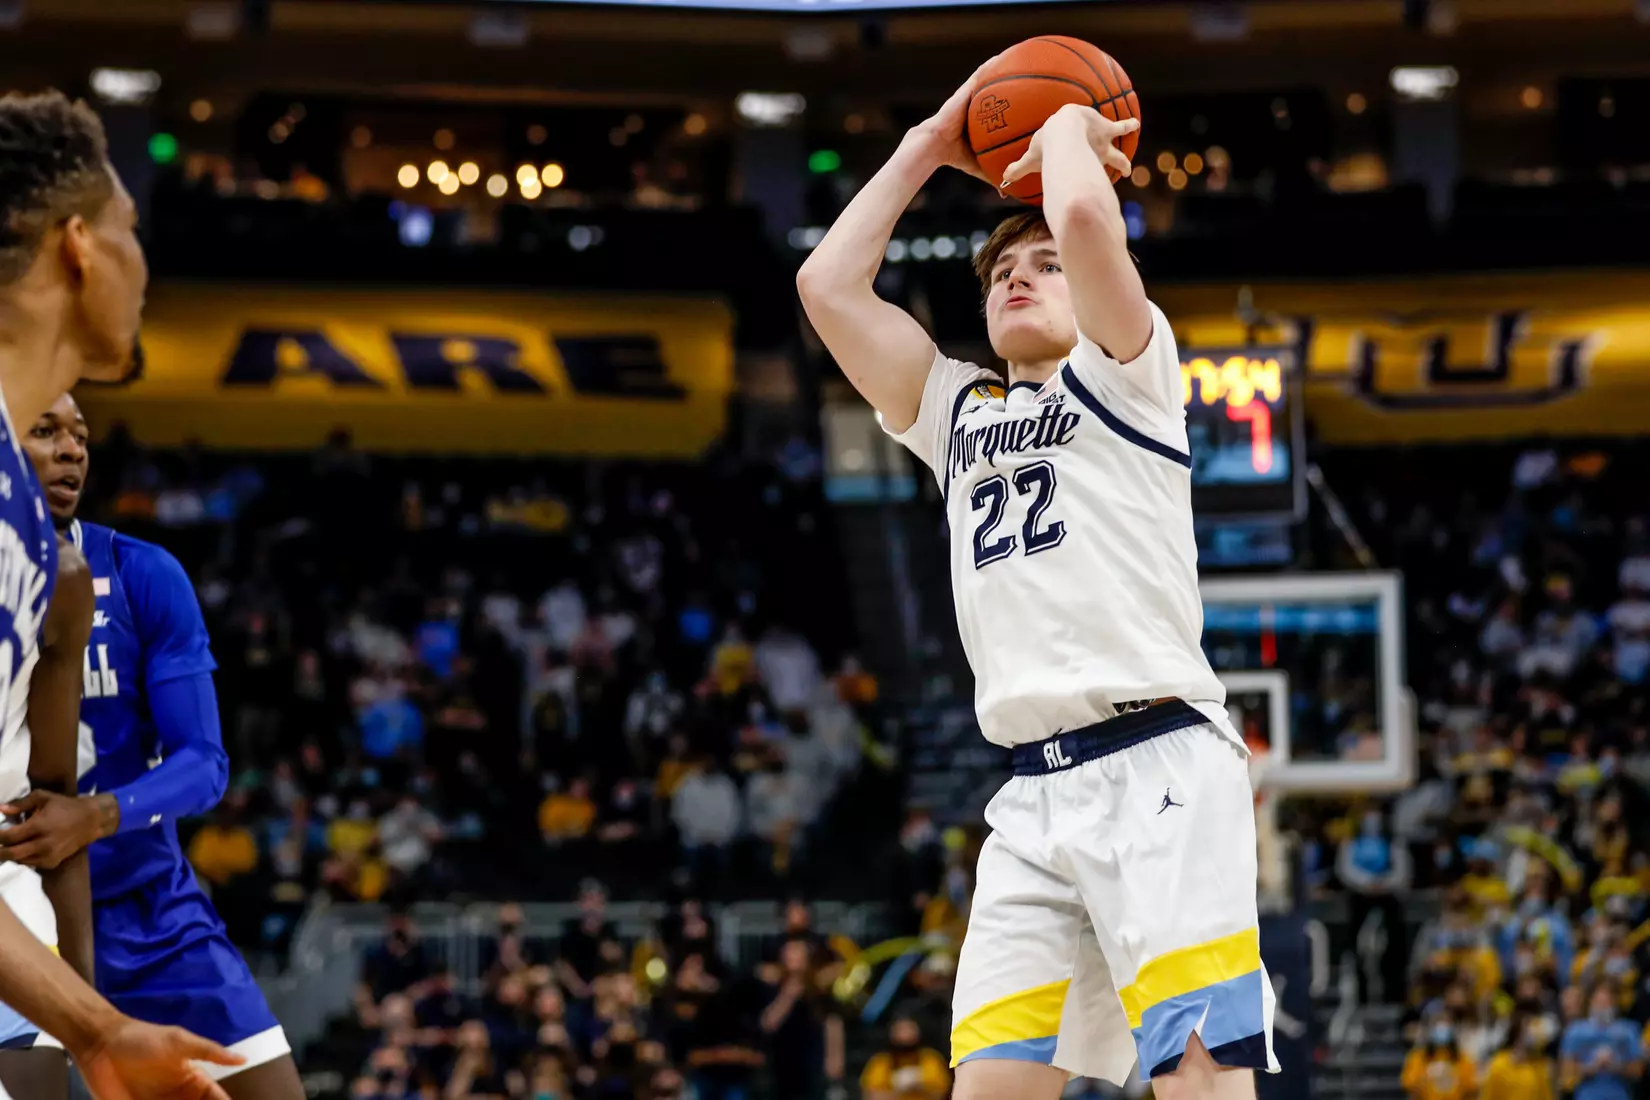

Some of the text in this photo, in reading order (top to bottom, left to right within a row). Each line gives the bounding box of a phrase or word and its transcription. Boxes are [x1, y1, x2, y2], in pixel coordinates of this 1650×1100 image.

[220, 328, 690, 403] ARE
[952, 402, 1081, 479] Marquette
[1226, 400, 1273, 474] 7
[970, 459, 1067, 571] 22
[82, 643, 119, 698] LL
